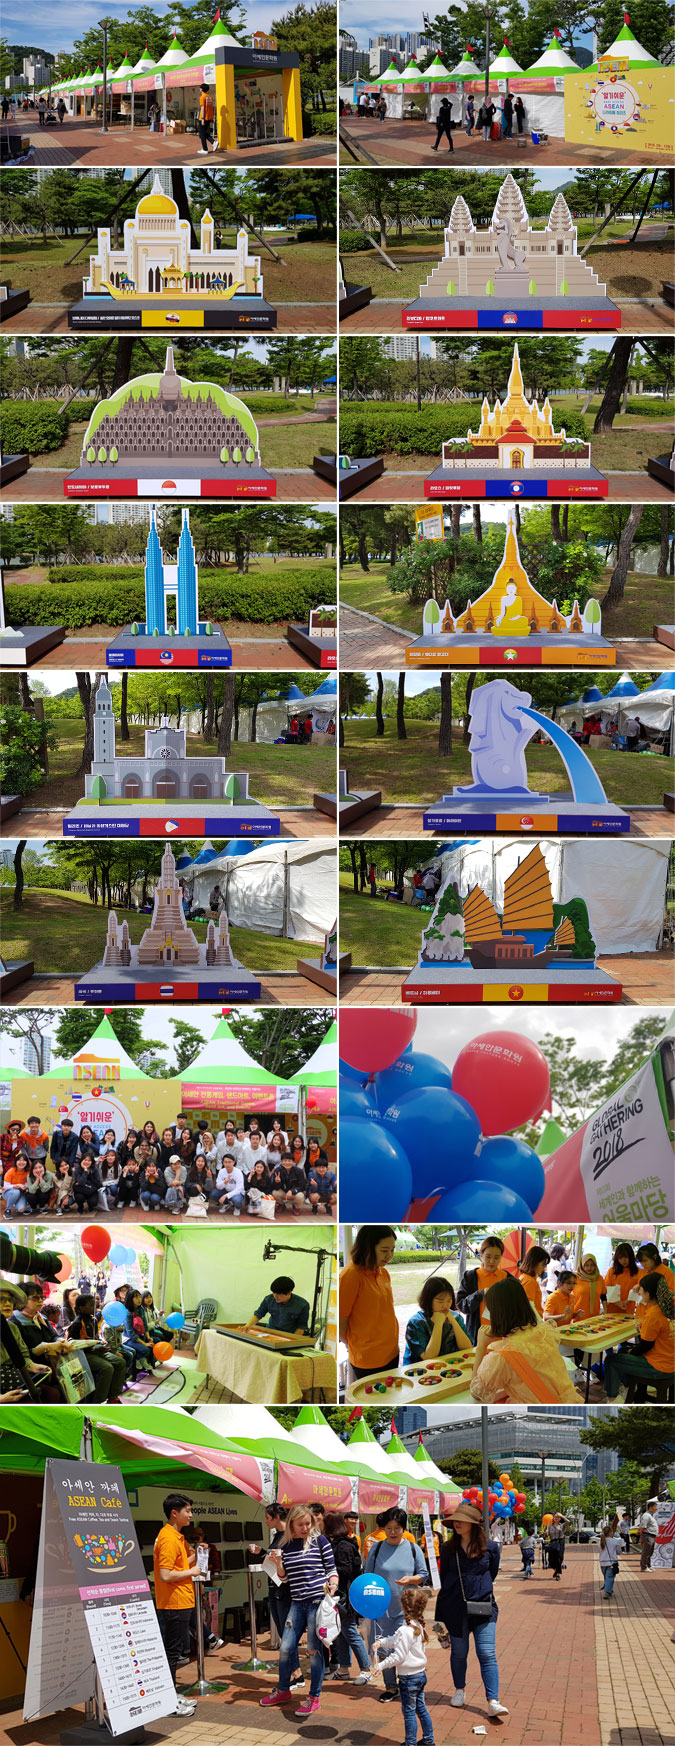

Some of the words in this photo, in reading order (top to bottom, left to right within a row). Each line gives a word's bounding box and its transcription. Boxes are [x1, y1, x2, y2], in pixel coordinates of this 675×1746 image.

[73, 1064, 120, 1080] ASEAN
[590, 1098, 643, 1144] GATHERING
[592, 1098, 624, 1132] GLOBAL
[593, 1128, 632, 1176] 2018
[599, 1188, 625, 1209] 세계인과
[626, 1176, 661, 1197] 함께하는
[62, 1478, 95, 1493] 아세안
[68, 1496, 97, 1507] ASEAN
[100, 1496, 122, 1508] Café
[191, 1507, 206, 1515] eople
